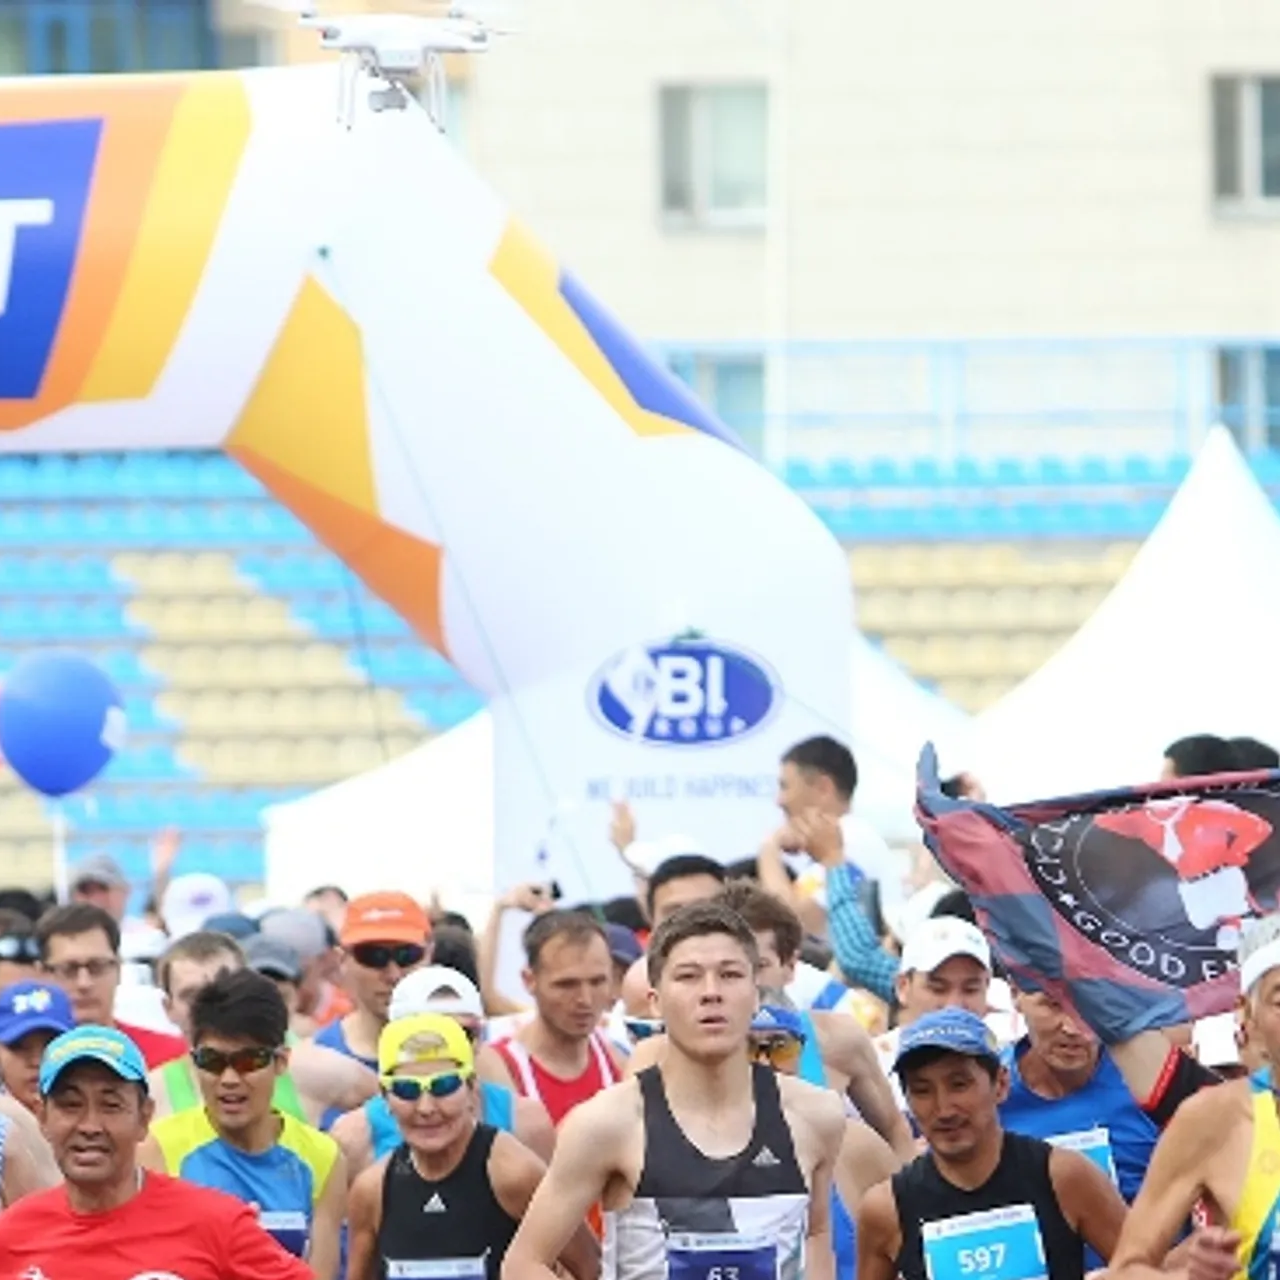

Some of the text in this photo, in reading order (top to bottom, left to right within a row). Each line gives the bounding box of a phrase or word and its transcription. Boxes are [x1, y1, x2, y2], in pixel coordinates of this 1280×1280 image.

[658, 655, 727, 717] BI
[1073, 911, 1186, 979] GOOD
[957, 1243, 1006, 1275] 597
